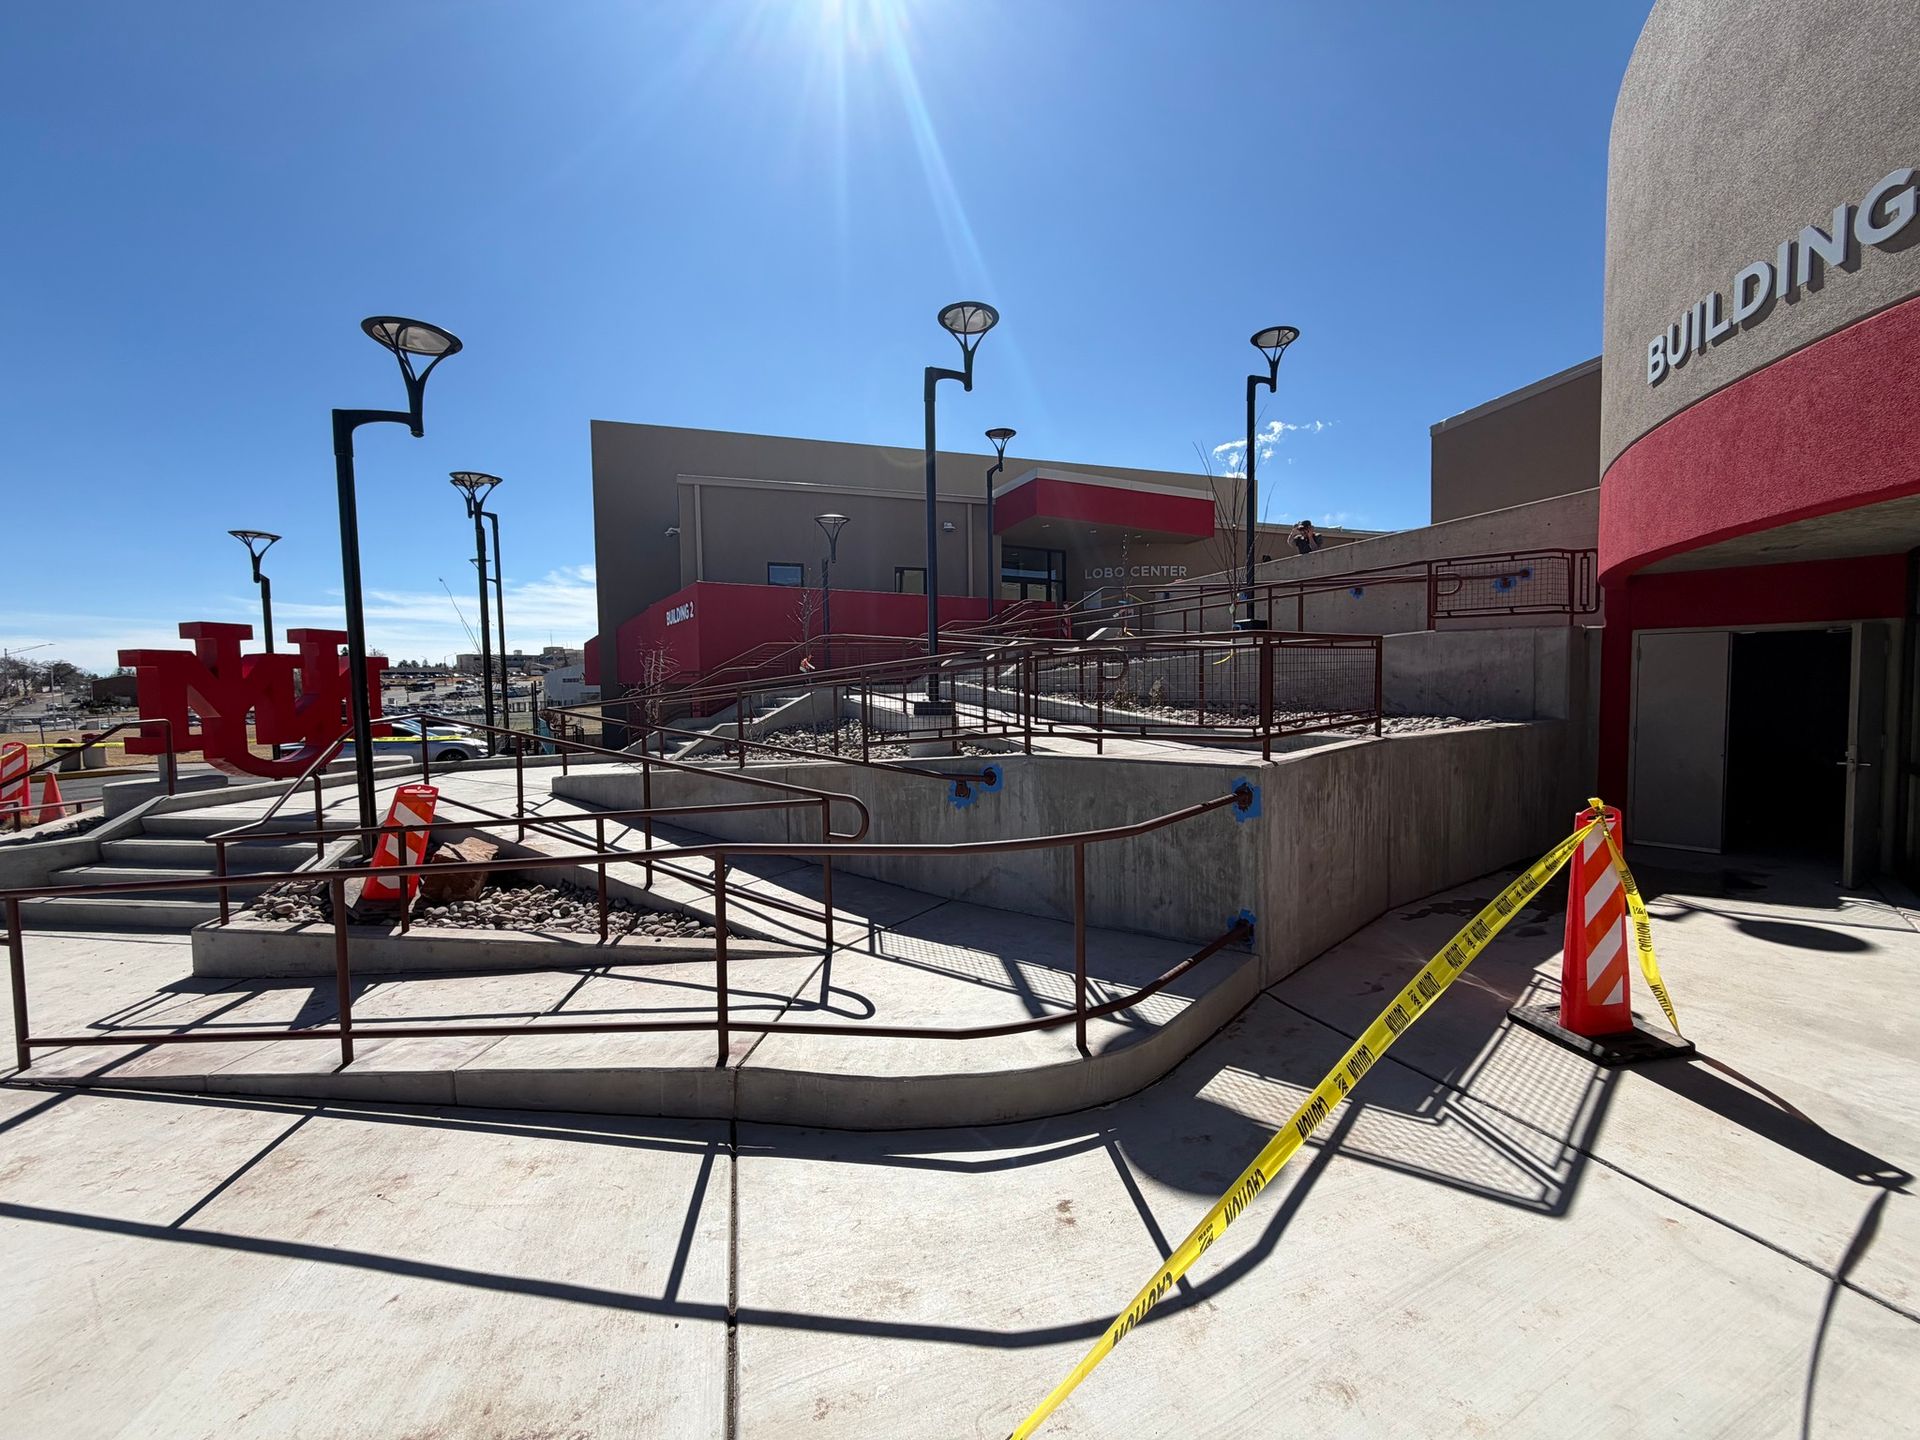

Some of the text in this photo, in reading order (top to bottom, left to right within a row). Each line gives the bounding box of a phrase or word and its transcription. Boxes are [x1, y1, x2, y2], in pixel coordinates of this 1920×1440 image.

[1647, 167, 1918, 385] BUILDING
[1084, 565, 1187, 579] LOBO CENTER
[666, 603, 689, 626] BUILDING
[1296, 1095, 1329, 1139] CAUTION
[1224, 1167, 1266, 1229] CAUTION
[1112, 1271, 1173, 1348] CAUTION
